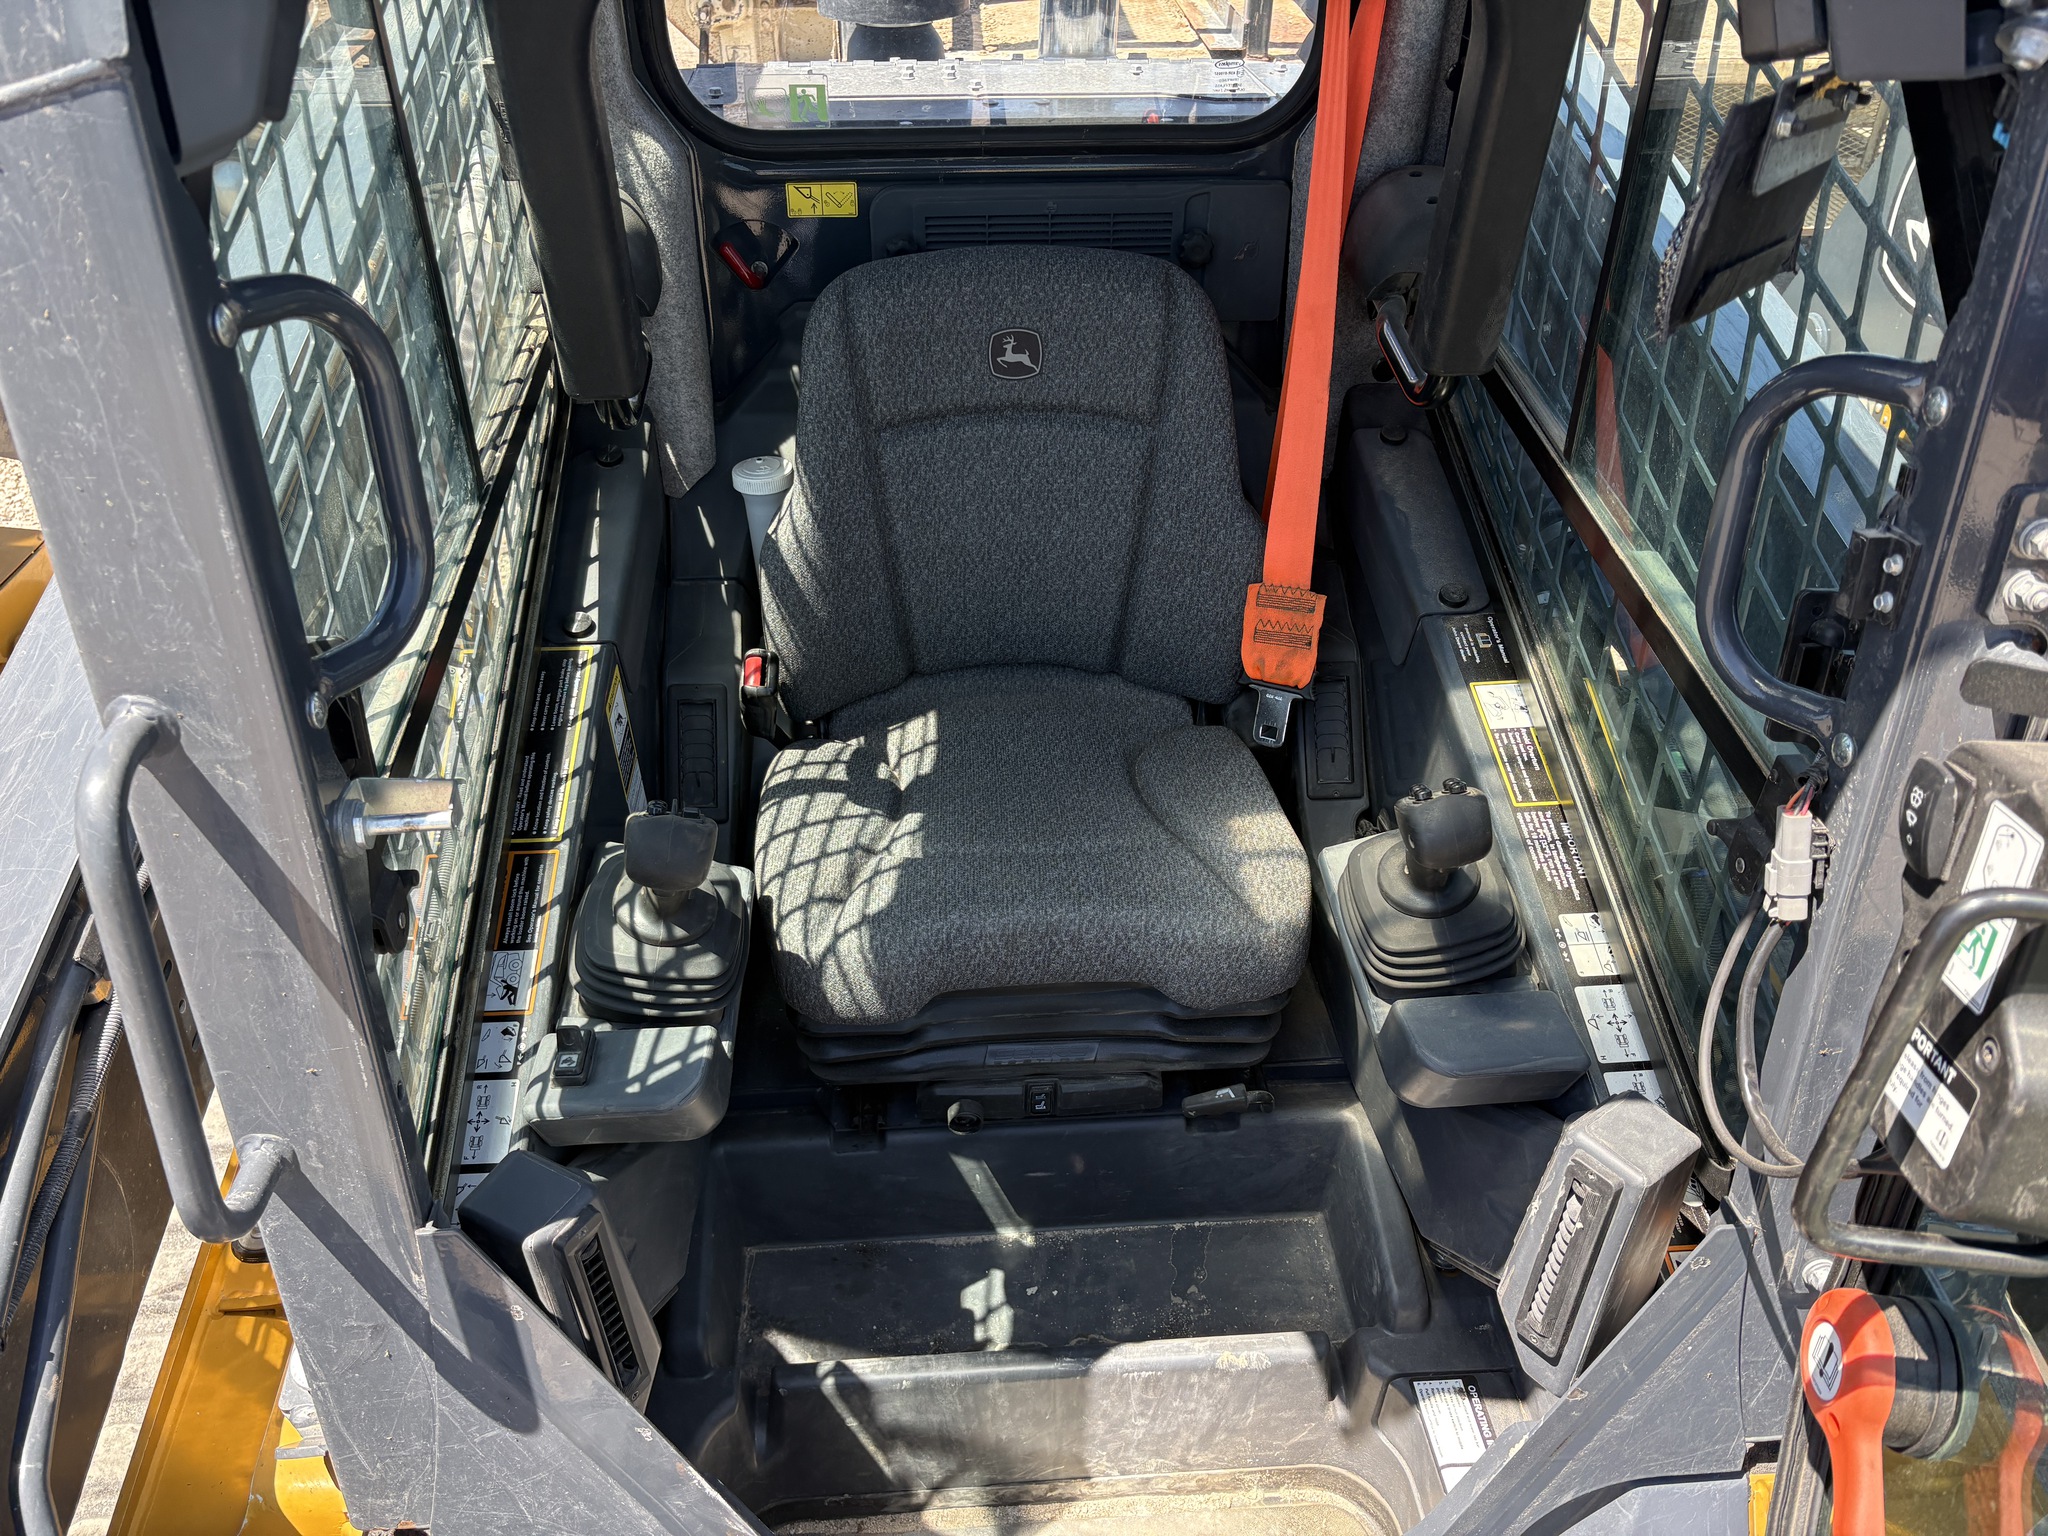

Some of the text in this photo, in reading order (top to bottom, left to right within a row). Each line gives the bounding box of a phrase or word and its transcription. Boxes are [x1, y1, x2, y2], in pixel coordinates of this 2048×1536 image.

[1459, 631, 1467, 646] contact
[1464, 627, 1473, 641] manual
[1487, 616, 1511, 664] Operator's Manual
[1498, 746, 1507, 761] operate
[1513, 732, 1521, 743] Carry
[1520, 728, 1540, 770] Avoid Overturn
[521, 755, 529, 777] understand
[517, 809, 525, 830] Operator's
[1547, 818, 1559, 839] prevent
[1555, 840, 1568, 863] damage
[1516, 812, 1528, 837] operation
[1528, 846, 1541, 870] controls.
[1531, 811, 1540, 827] below
[1554, 876, 1562, 890] slow
[1533, 839, 1546, 862] minutes
[1542, 863, 1552, 881] before
[1541, 822, 1552, 842] engine,
[1551, 850, 1568, 887] temperatures
[528, 909, 536, 933] Operator's
[1911, 1026, 1957, 1085] PORTANT
[1918, 1070, 1934, 1090] from
[1468, 1385, 1493, 1439] OPERATING
